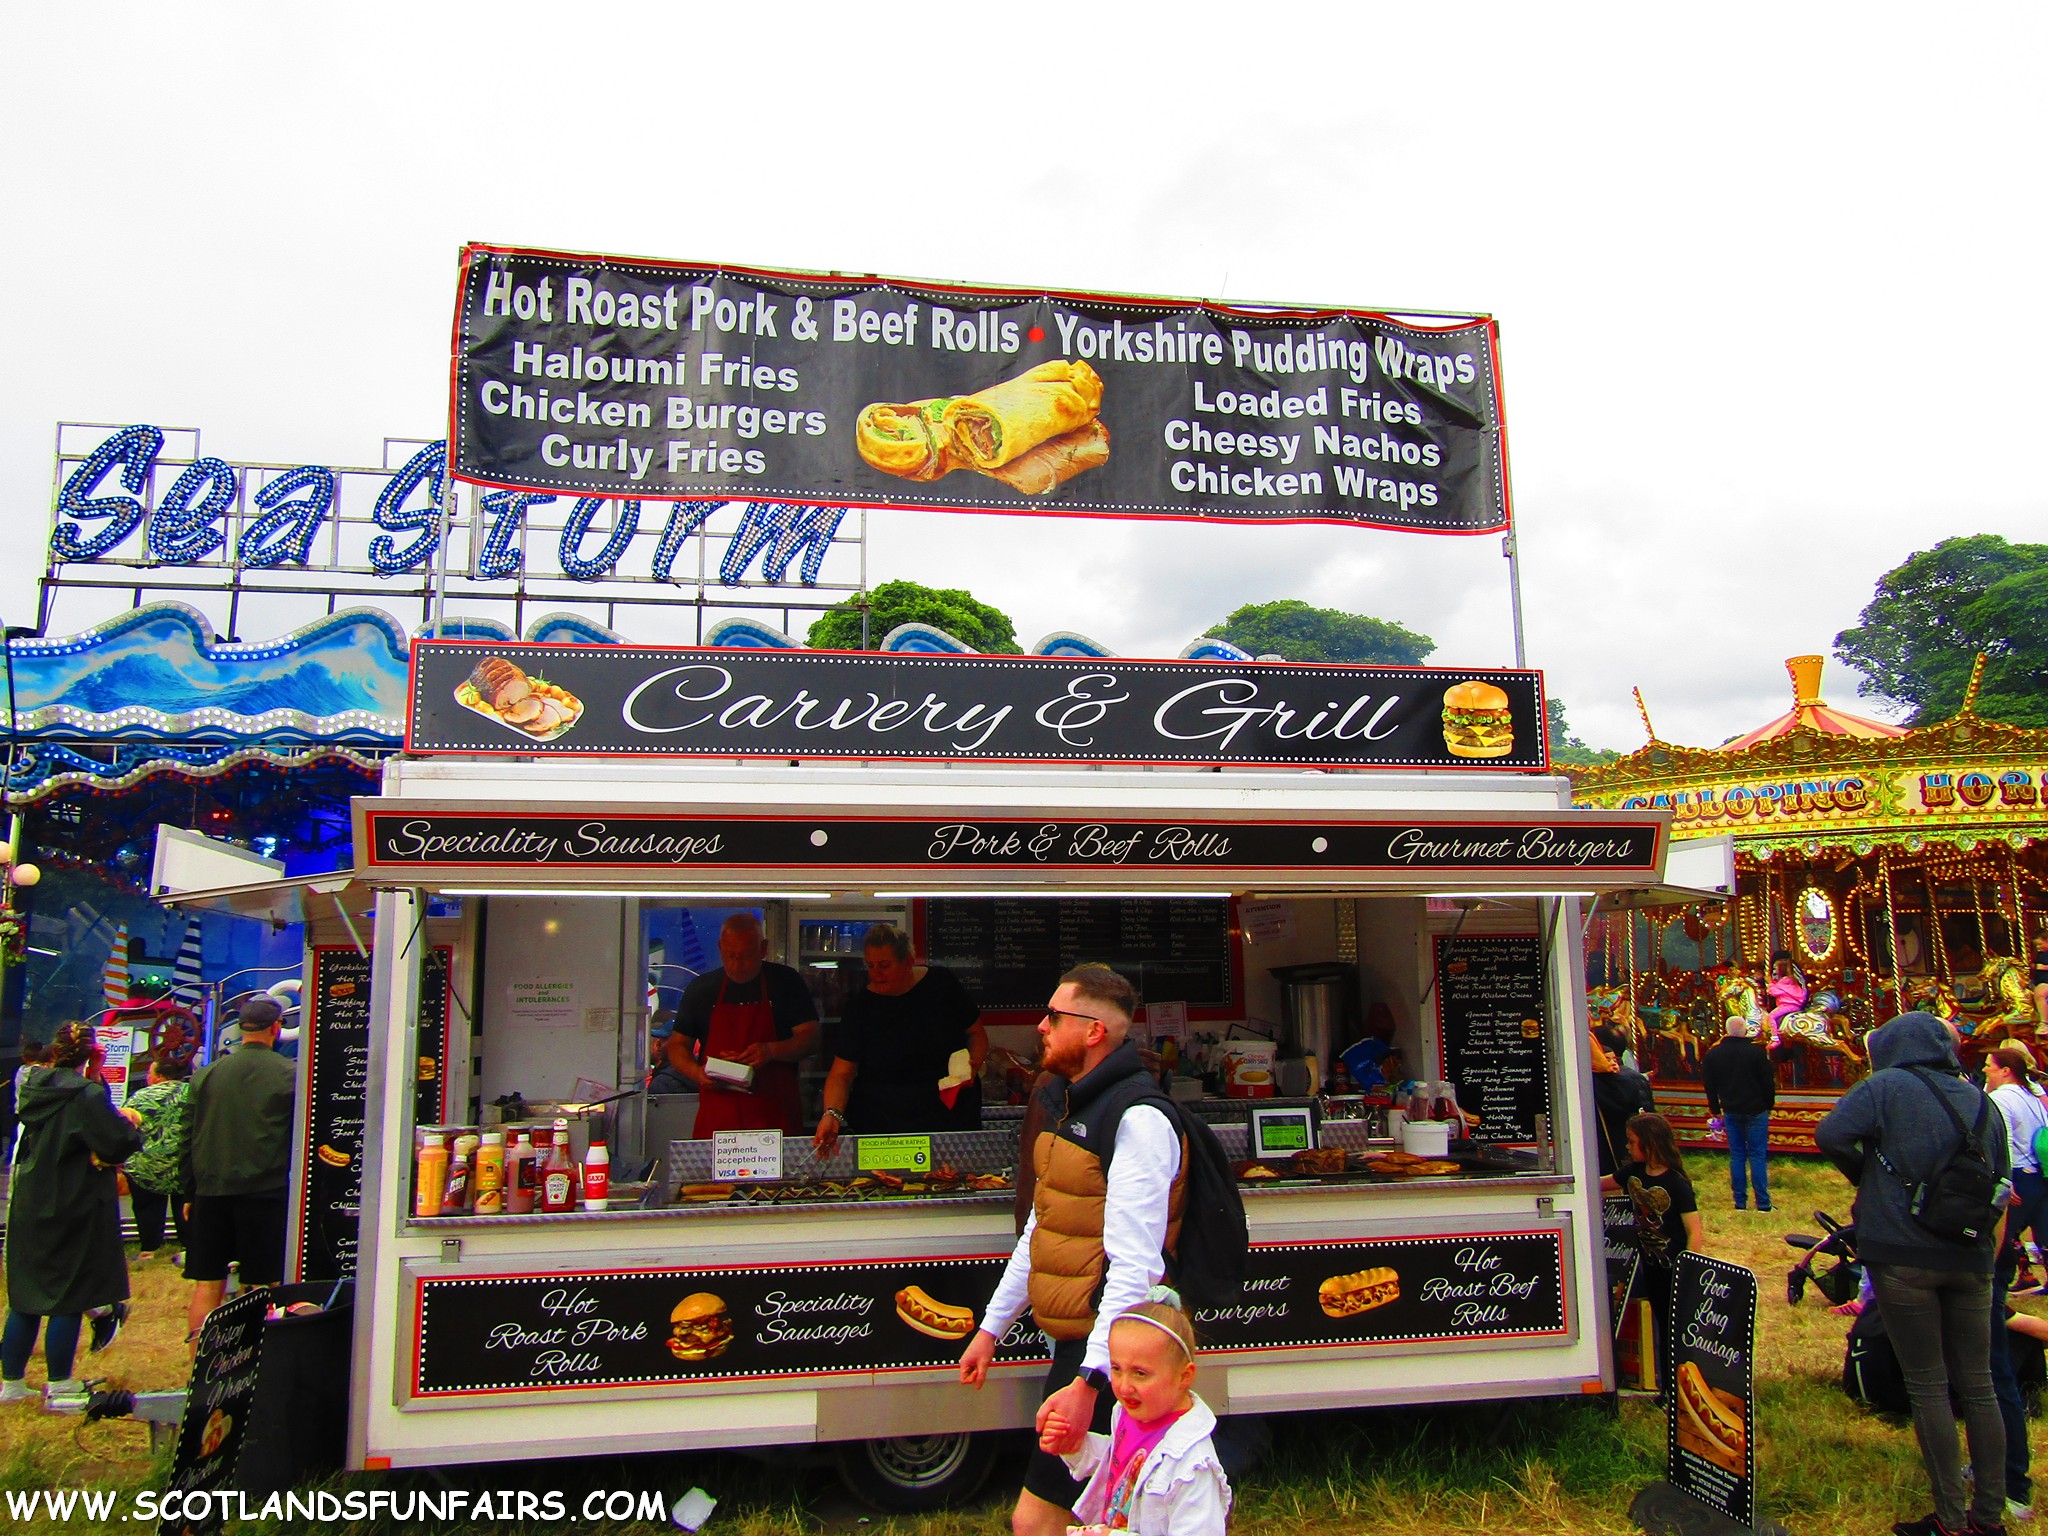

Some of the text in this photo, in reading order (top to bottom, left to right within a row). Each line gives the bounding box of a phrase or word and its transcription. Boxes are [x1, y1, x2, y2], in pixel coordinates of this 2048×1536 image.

[485, 270, 1021, 354] Hot Roast Pork & Beef Rolls
[1054, 311, 1476, 392] Yorkshire Pudding Wraps
[513, 340, 800, 393] Haloumi Fries
[480, 379, 828, 439] Chicken Burgers
[1194, 381, 1422, 426] Loaded Fries
[1163, 418, 1441, 467] Cheesy Nachos
[540, 433, 767, 482] Curly Fries
[50, 425, 336, 568] Sea
[1170, 460, 1438, 507] Chicken Wraps
[622, 664, 1400, 752] Carvery & Grill
[1919, 771, 2048, 808] HOR
[388, 820, 725, 863] Speciality Sausages
[928, 824, 1232, 864] Pork & Beef Rolls
[1388, 828, 1633, 867] Gourmet Burgers
[1245, 903, 1281, 913] ATTENTION
[1447, 974, 1479, 982] Stuffing
[1495, 982, 1511, 990] Beef
[1513, 982, 1529, 990] Roll
[326, 998, 366, 1008] Stuffing
[1509, 991, 1533, 999] Onions
[330, 1021, 352, 1029] With
[334, 1009, 353, 1017] Hot
[1468, 1020, 1519, 1028] Steak Burgers
[1469, 1029, 1520, 1037] Cheese Burgers
[1497, 1038, 1523, 1046] Burgers
[1459, 1048, 1480, 1056] Bacon
[1507, 1047, 1533, 1056] Burgers
[1461, 1066, 1532, 1075] Speciality Sausages
[1463, 1076, 1482, 1085] Foot
[1502, 1075, 1532, 1084] Sausage
[330, 1092, 357, 1100] Bacon
[331, 1128, 355, 1139] Foot
[1468, 1131, 1533, 1140] Chilli Cheese Dogs
[1478, 1121, 1521, 1131] Cheese Dogs
[717, 1136, 737, 1145] card
[717, 1146, 758, 1156] payments
[717, 1156, 757, 1165] accepted
[717, 1169, 737, 1177] VISA
[1453, 1247, 1501, 1273] Hot
[1243, 1275, 1291, 1292] rmet
[1420, 1274, 1539, 1301] Roast Beef
[1699, 1268, 1731, 1299] Foot
[541, 1288, 600, 1317] Hot
[755, 1290, 875, 1317] Speciality
[1450, 1302, 1509, 1328] Rolls
[1694, 1297, 1729, 1331] Long
[201, 1322, 247, 1358] Crispy
[484, 1319, 648, 1350] Roast Pork
[755, 1319, 874, 1347] Sausages
[1681, 1323, 1741, 1367] Sausage
[205, 1345, 254, 1385] Chicken
[530, 1350, 603, 1377] Rolls
